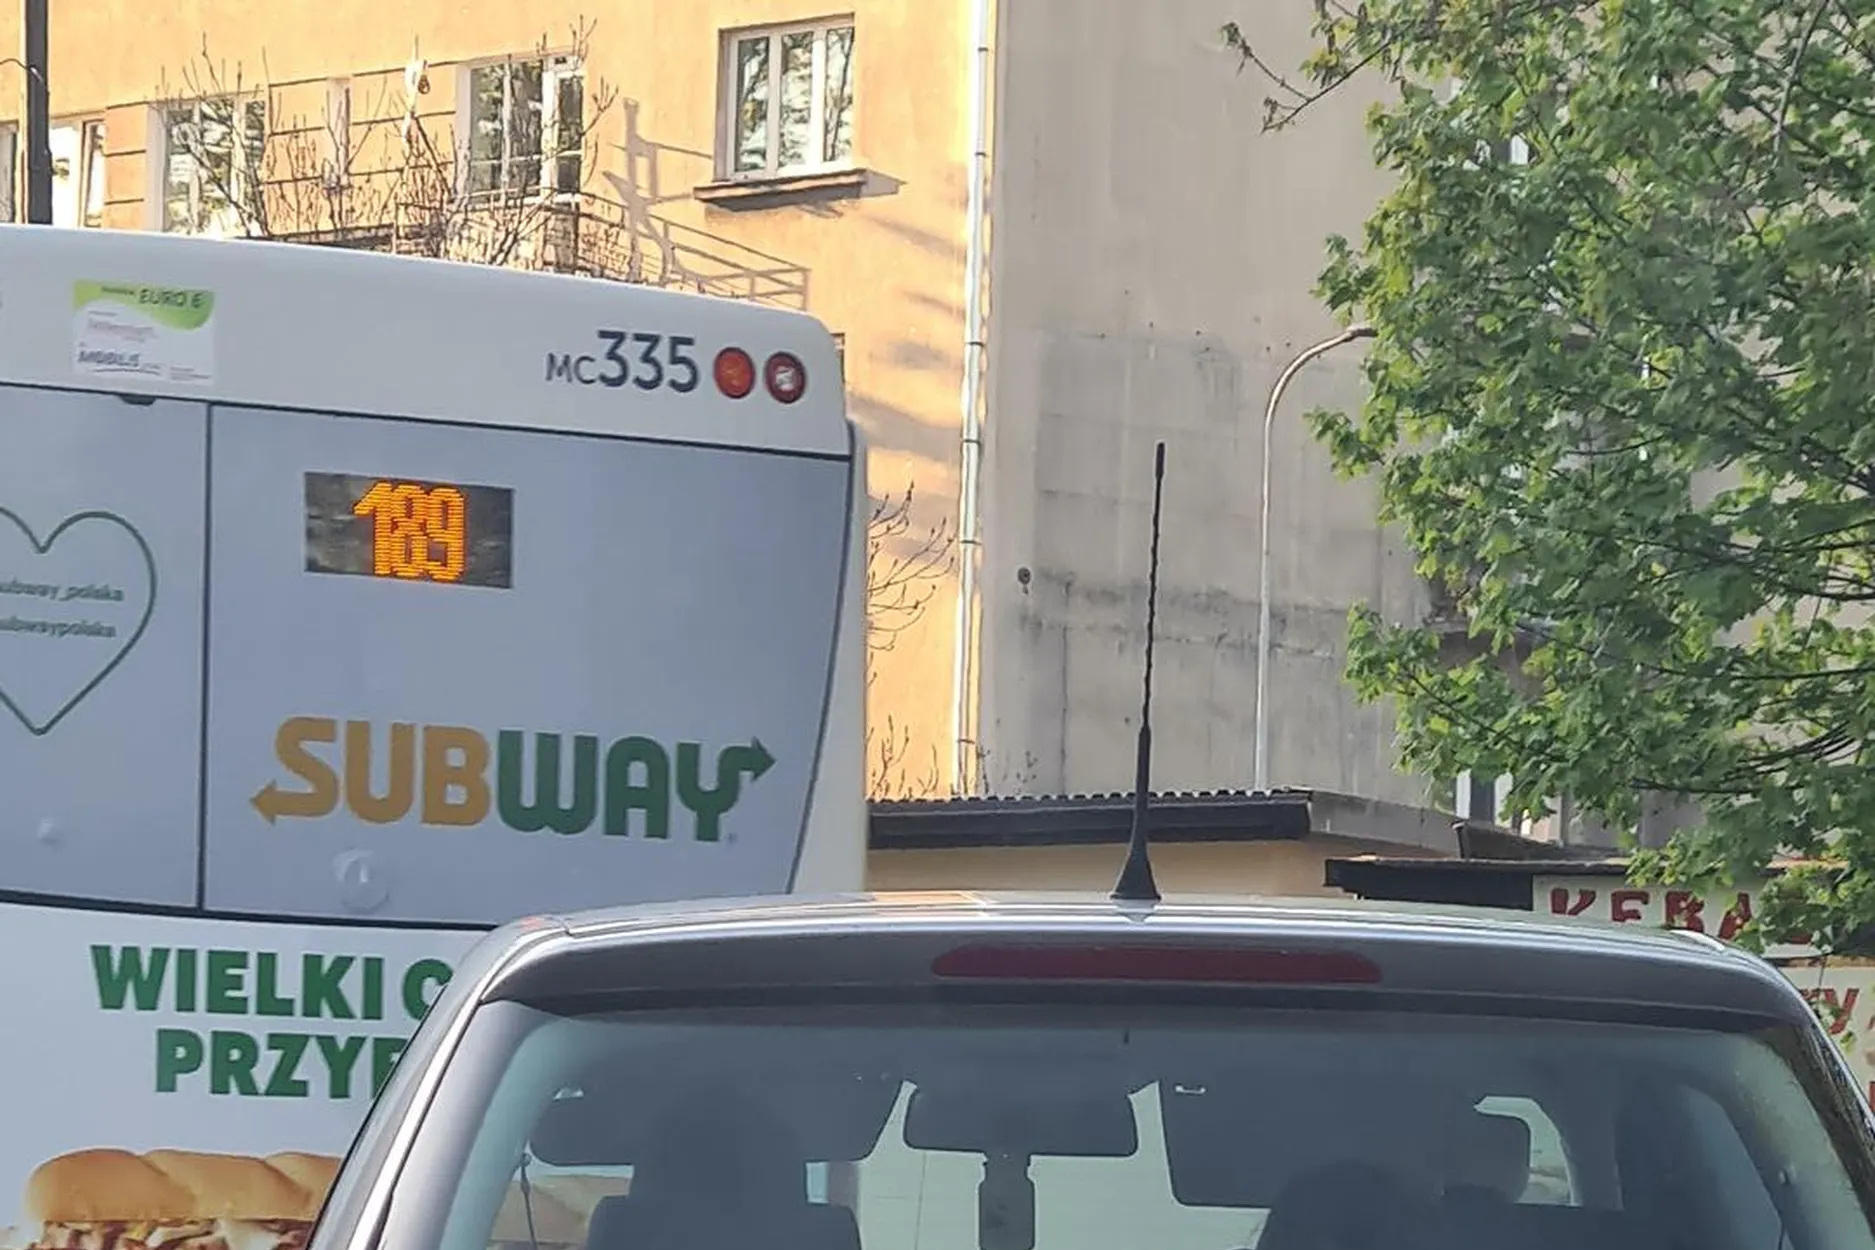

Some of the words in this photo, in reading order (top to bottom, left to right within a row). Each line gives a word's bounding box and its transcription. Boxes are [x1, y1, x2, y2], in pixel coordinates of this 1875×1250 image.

[353, 481, 466, 582] 189
[250, 716, 777, 842] SUBWAY
[90, 944, 384, 1020] WIELKI
